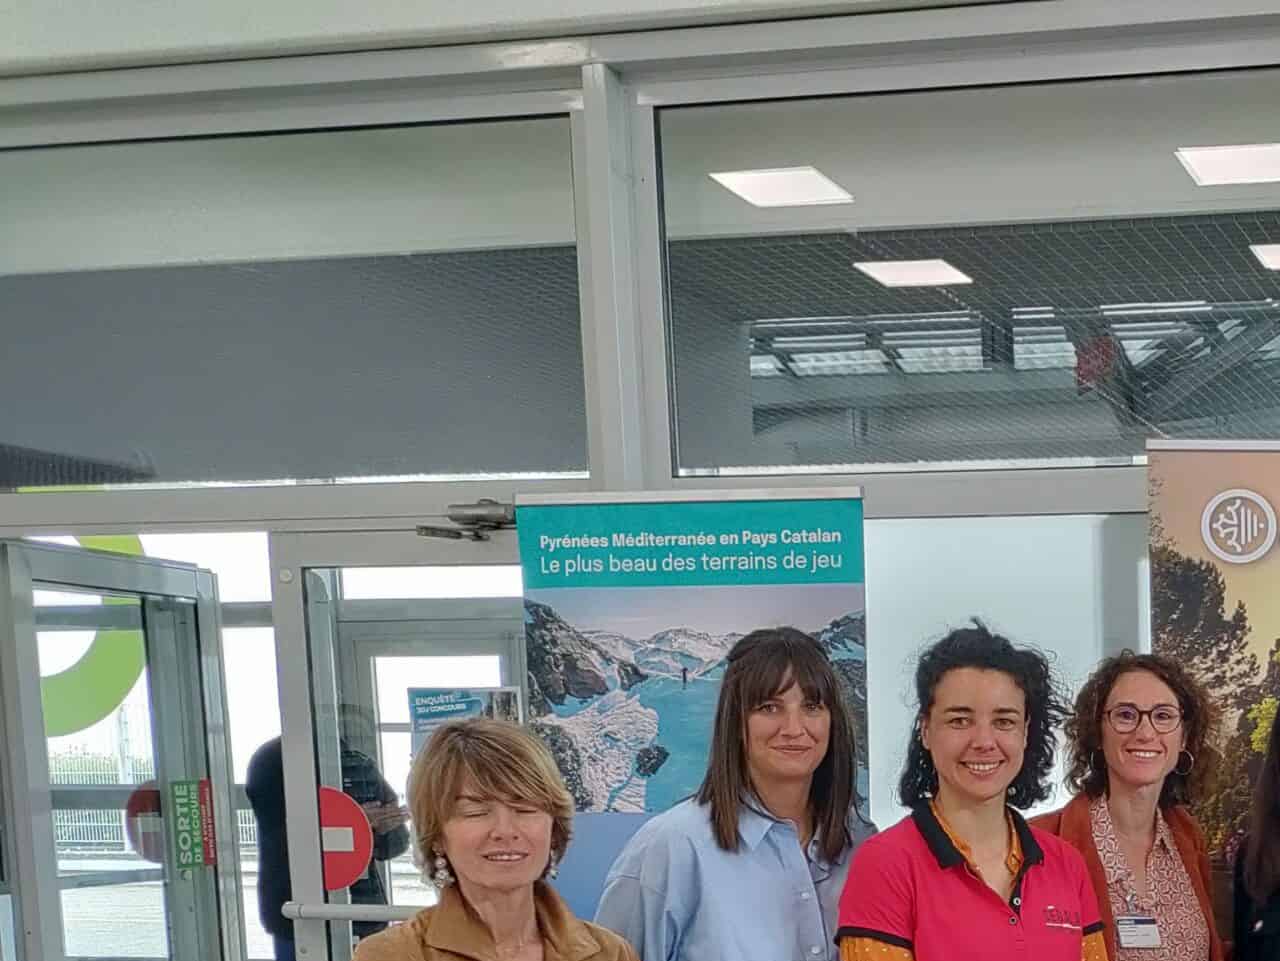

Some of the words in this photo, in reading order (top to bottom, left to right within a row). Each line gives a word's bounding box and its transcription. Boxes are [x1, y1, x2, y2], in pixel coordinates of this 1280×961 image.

[540, 534, 608, 551] Pyrénées
[612, 531, 716, 547] Méditerranée
[719, 533, 739, 546] en
[742, 532, 777, 548] Pays
[781, 530, 841, 545] Catalan
[541, 557, 560, 573] Le
[565, 554, 602, 576] plus
[609, 553, 657, 572] beau
[661, 552, 696, 571] des
[700, 551, 777, 570] terrains
[781, 550, 807, 569] de
[811, 550, 842, 573] jeu
[175, 784, 193, 864] SORTIE
